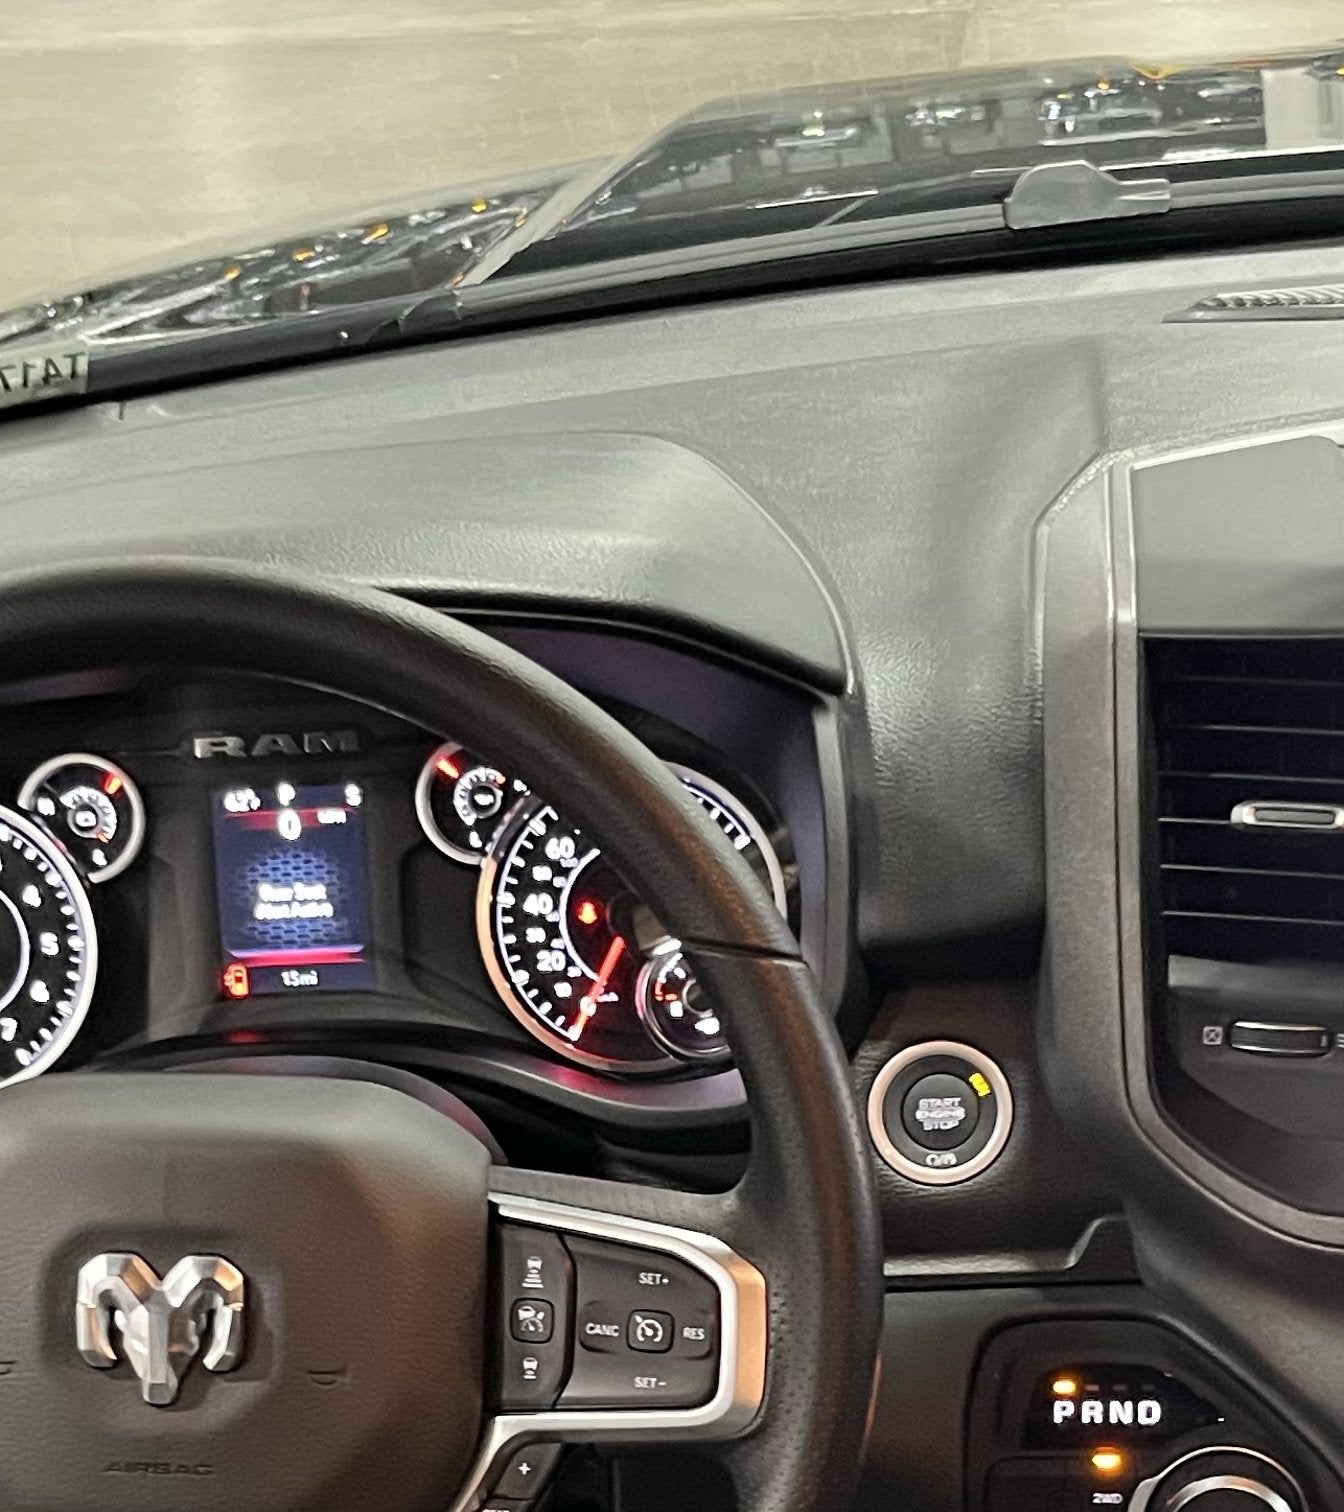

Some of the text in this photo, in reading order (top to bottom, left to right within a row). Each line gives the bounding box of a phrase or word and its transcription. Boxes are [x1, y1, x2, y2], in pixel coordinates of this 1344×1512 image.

[193, 732, 358, 758] RAM
[523, 892, 554, 915] 40
[40, 931, 60, 956] 5
[536, 950, 567, 972] 20
[682, 1326, 705, 1341] RES
[103, 1462, 216, 1476] AIRBAG
